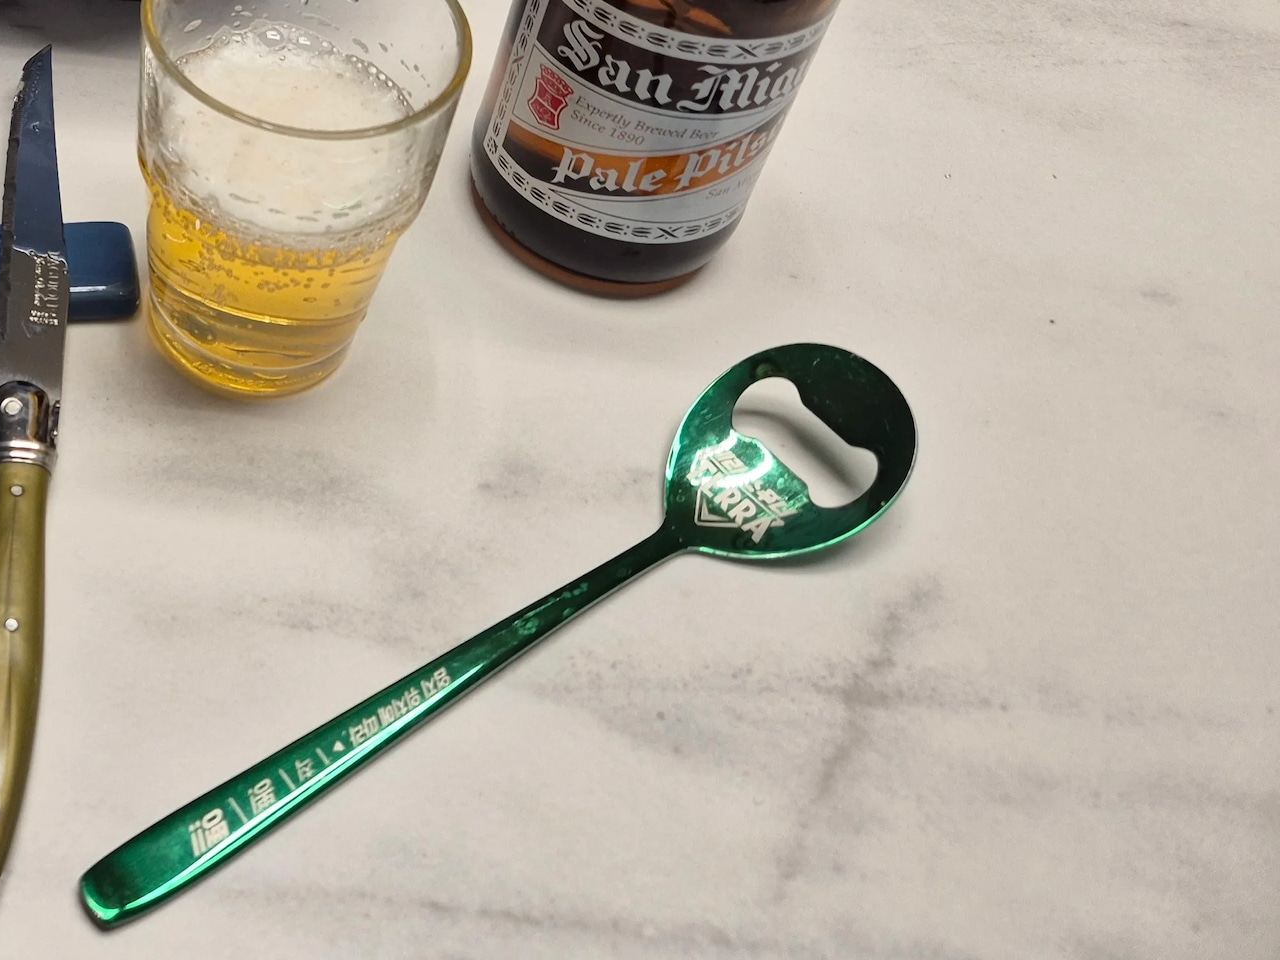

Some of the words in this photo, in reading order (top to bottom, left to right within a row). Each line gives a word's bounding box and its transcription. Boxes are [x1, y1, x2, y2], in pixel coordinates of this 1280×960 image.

[557, 19, 673, 106] San
[676, 59, 808, 113] Mig
[570, 109, 607, 134] Since
[609, 127, 646, 146] 1890
[575, 95, 632, 129] Expertly
[634, 120, 688, 139] Brewed
[689, 129, 720, 141] Beer
[675, 128, 774, 192] Pils
[687, 456, 772, 544] TERRA
